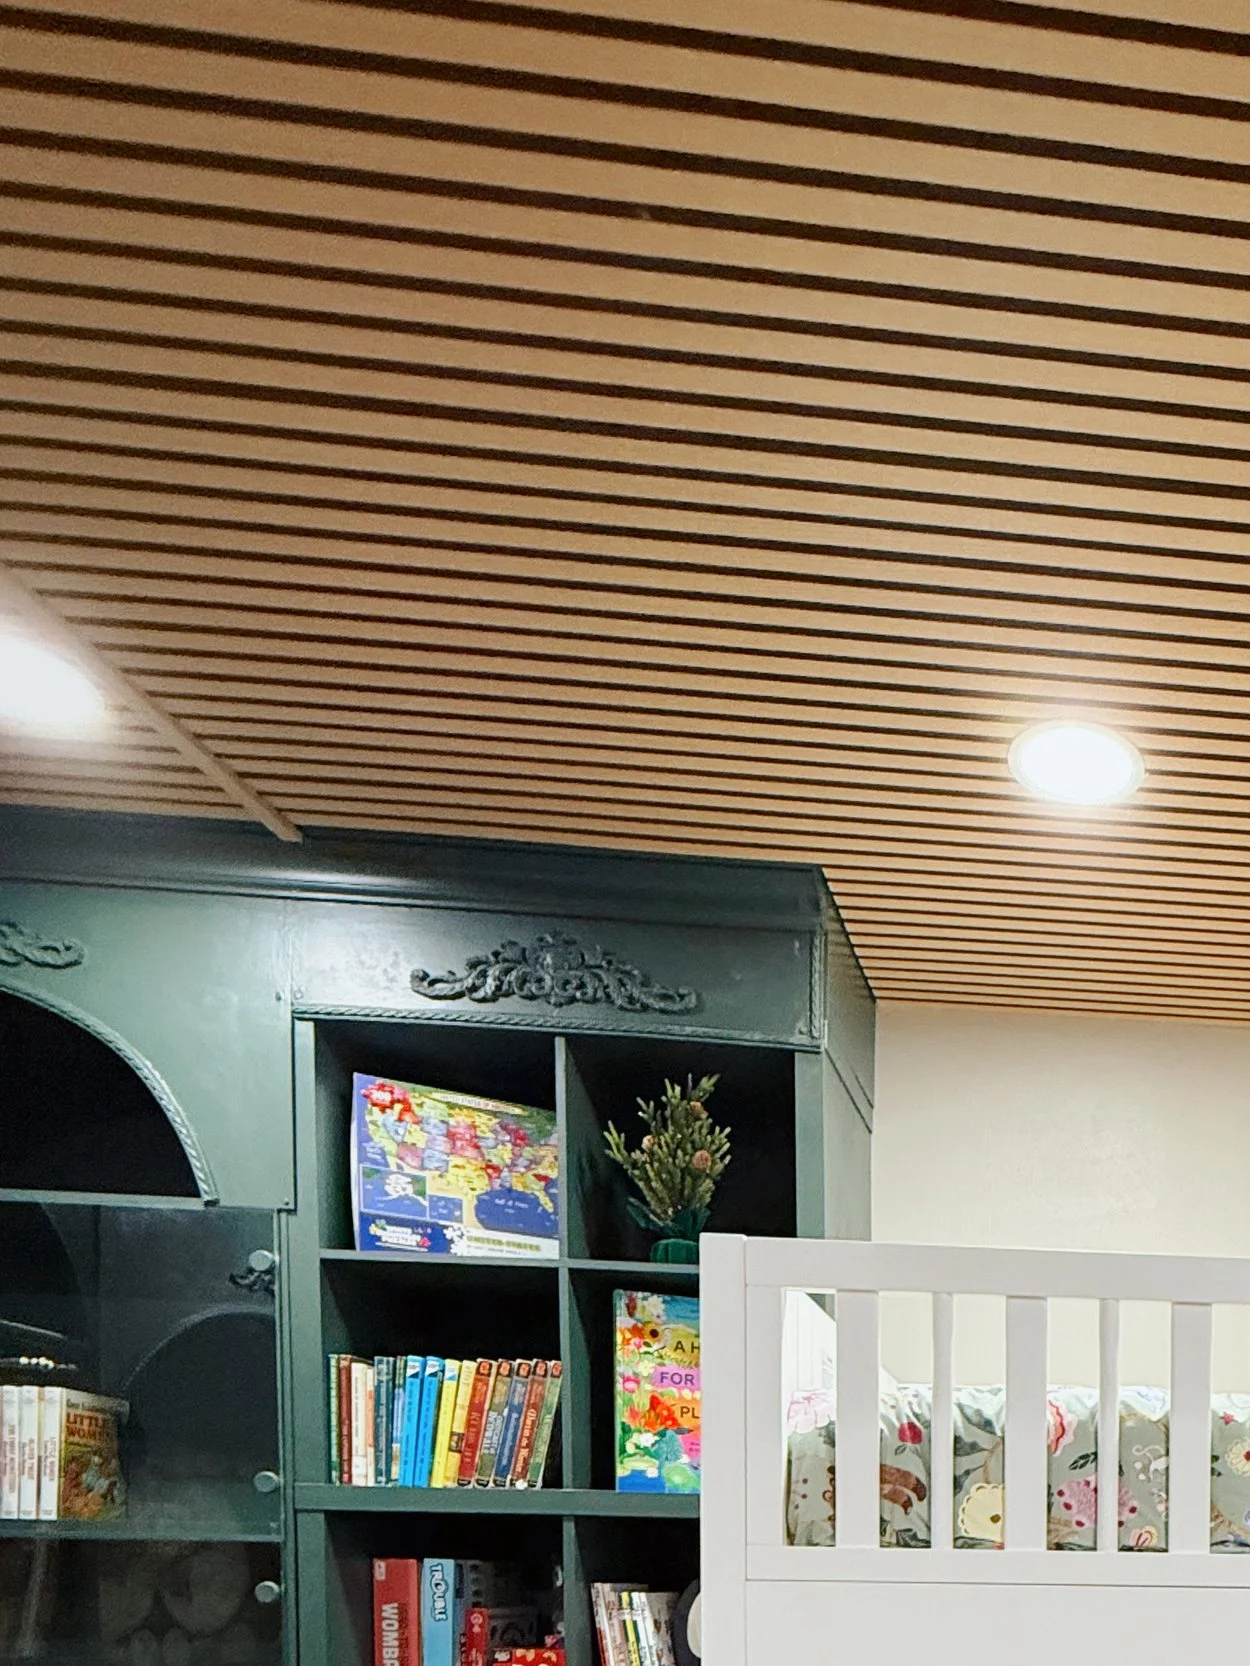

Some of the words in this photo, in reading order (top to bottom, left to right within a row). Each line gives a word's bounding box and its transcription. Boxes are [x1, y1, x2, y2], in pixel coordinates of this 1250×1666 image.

[673, 1340, 685, 1353] A
[659, 1371, 695, 1386] FOR
[429, 1563, 449, 1622] TROUBLE
